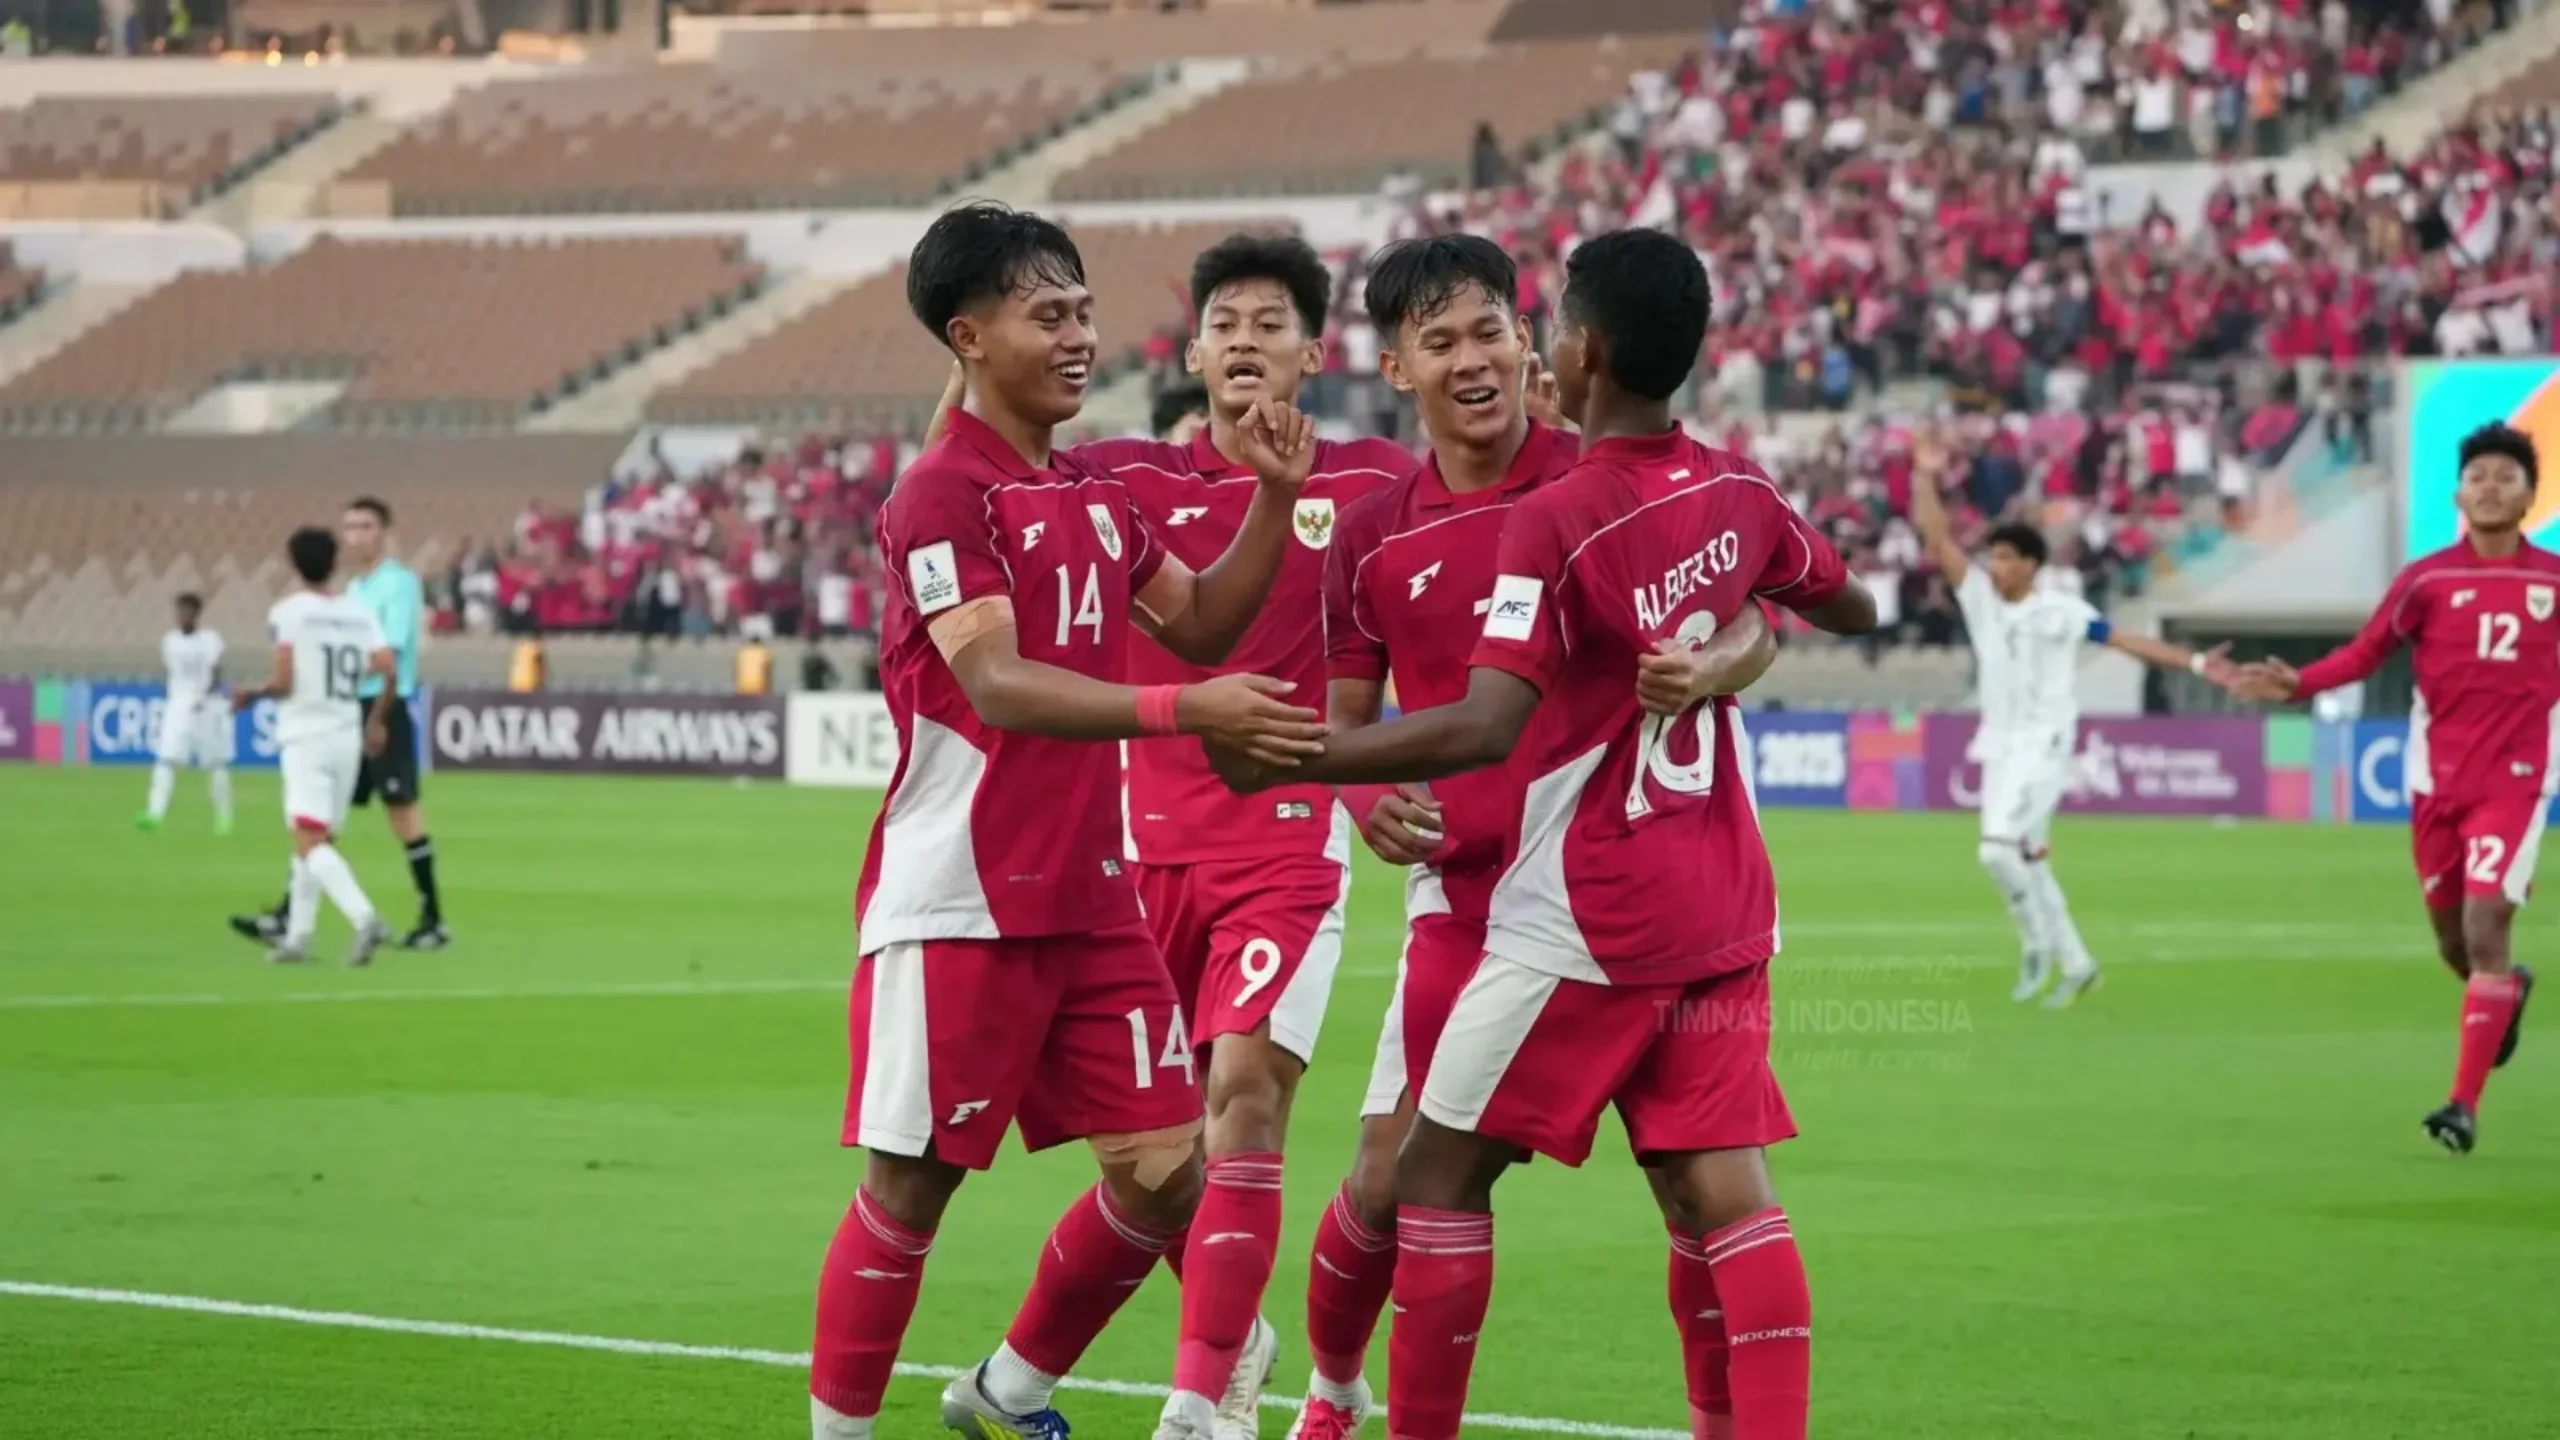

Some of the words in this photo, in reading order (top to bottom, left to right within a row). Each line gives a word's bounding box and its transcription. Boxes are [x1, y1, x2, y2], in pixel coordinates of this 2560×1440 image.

[1055, 562, 1104, 646] 14
[1496, 600, 1533, 617] AFC
[1634, 530, 1739, 631] ALBERTO
[2477, 612, 2521, 662] 12
[320, 642, 362, 701] 19
[436, 704, 581, 762] QATAR
[592, 705, 780, 765] AIRWAYS
[2465, 835, 2505, 883] 12
[1232, 937, 1281, 1008] 9
[1125, 1004, 1194, 1089] 14
